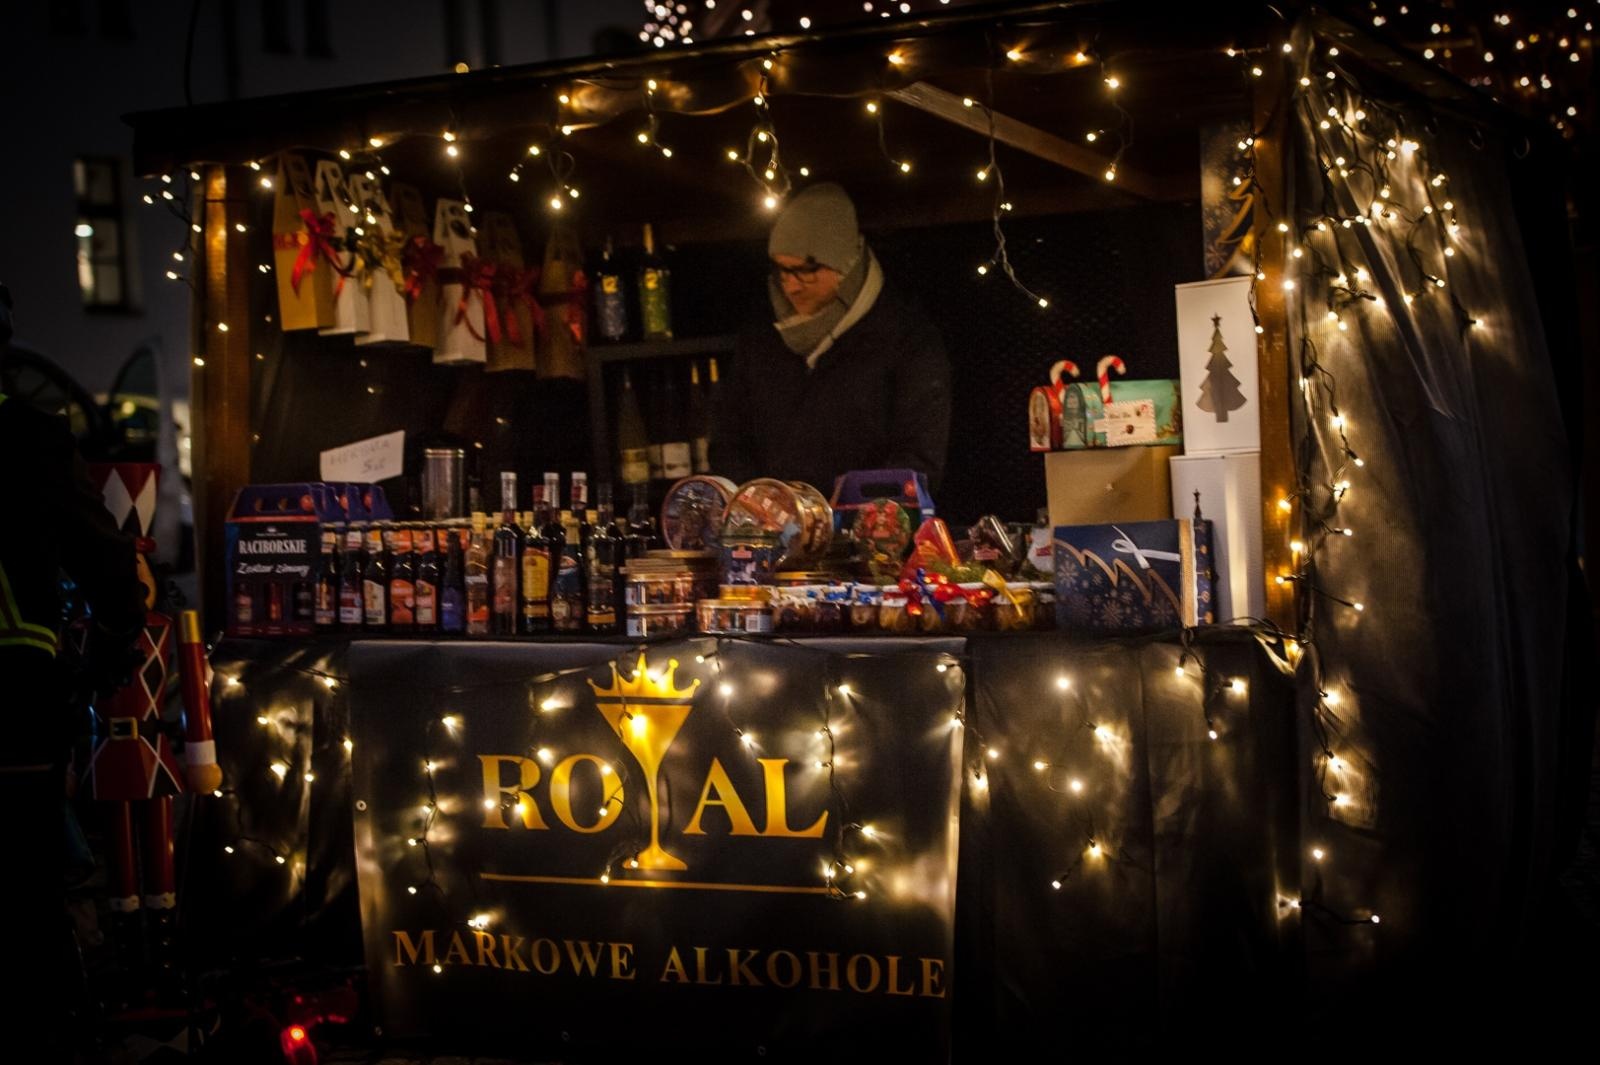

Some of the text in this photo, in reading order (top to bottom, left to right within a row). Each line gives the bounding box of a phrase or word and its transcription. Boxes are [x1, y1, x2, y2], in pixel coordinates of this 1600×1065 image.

[238, 539, 307, 555] RACIBORSKIE
[393, 929, 946, 999] MARKOWE ALKOHOLE
